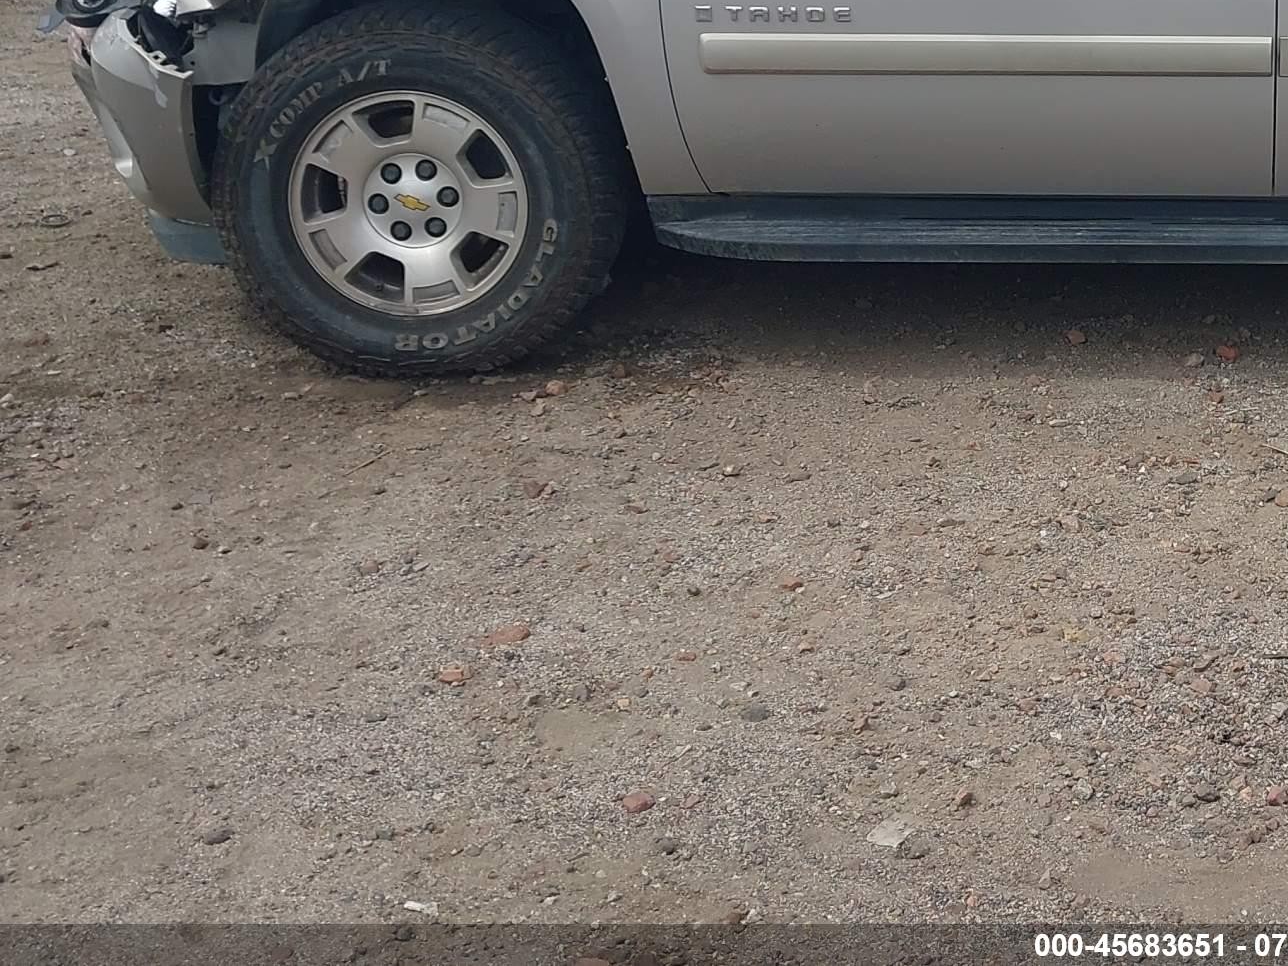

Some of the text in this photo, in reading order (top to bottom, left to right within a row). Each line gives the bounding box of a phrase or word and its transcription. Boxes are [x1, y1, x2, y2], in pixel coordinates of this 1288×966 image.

[724, 6, 851, 22] TAHOE
[338, 59, 392, 87] A/T
[394, 218, 558, 351] GLADIATOR
